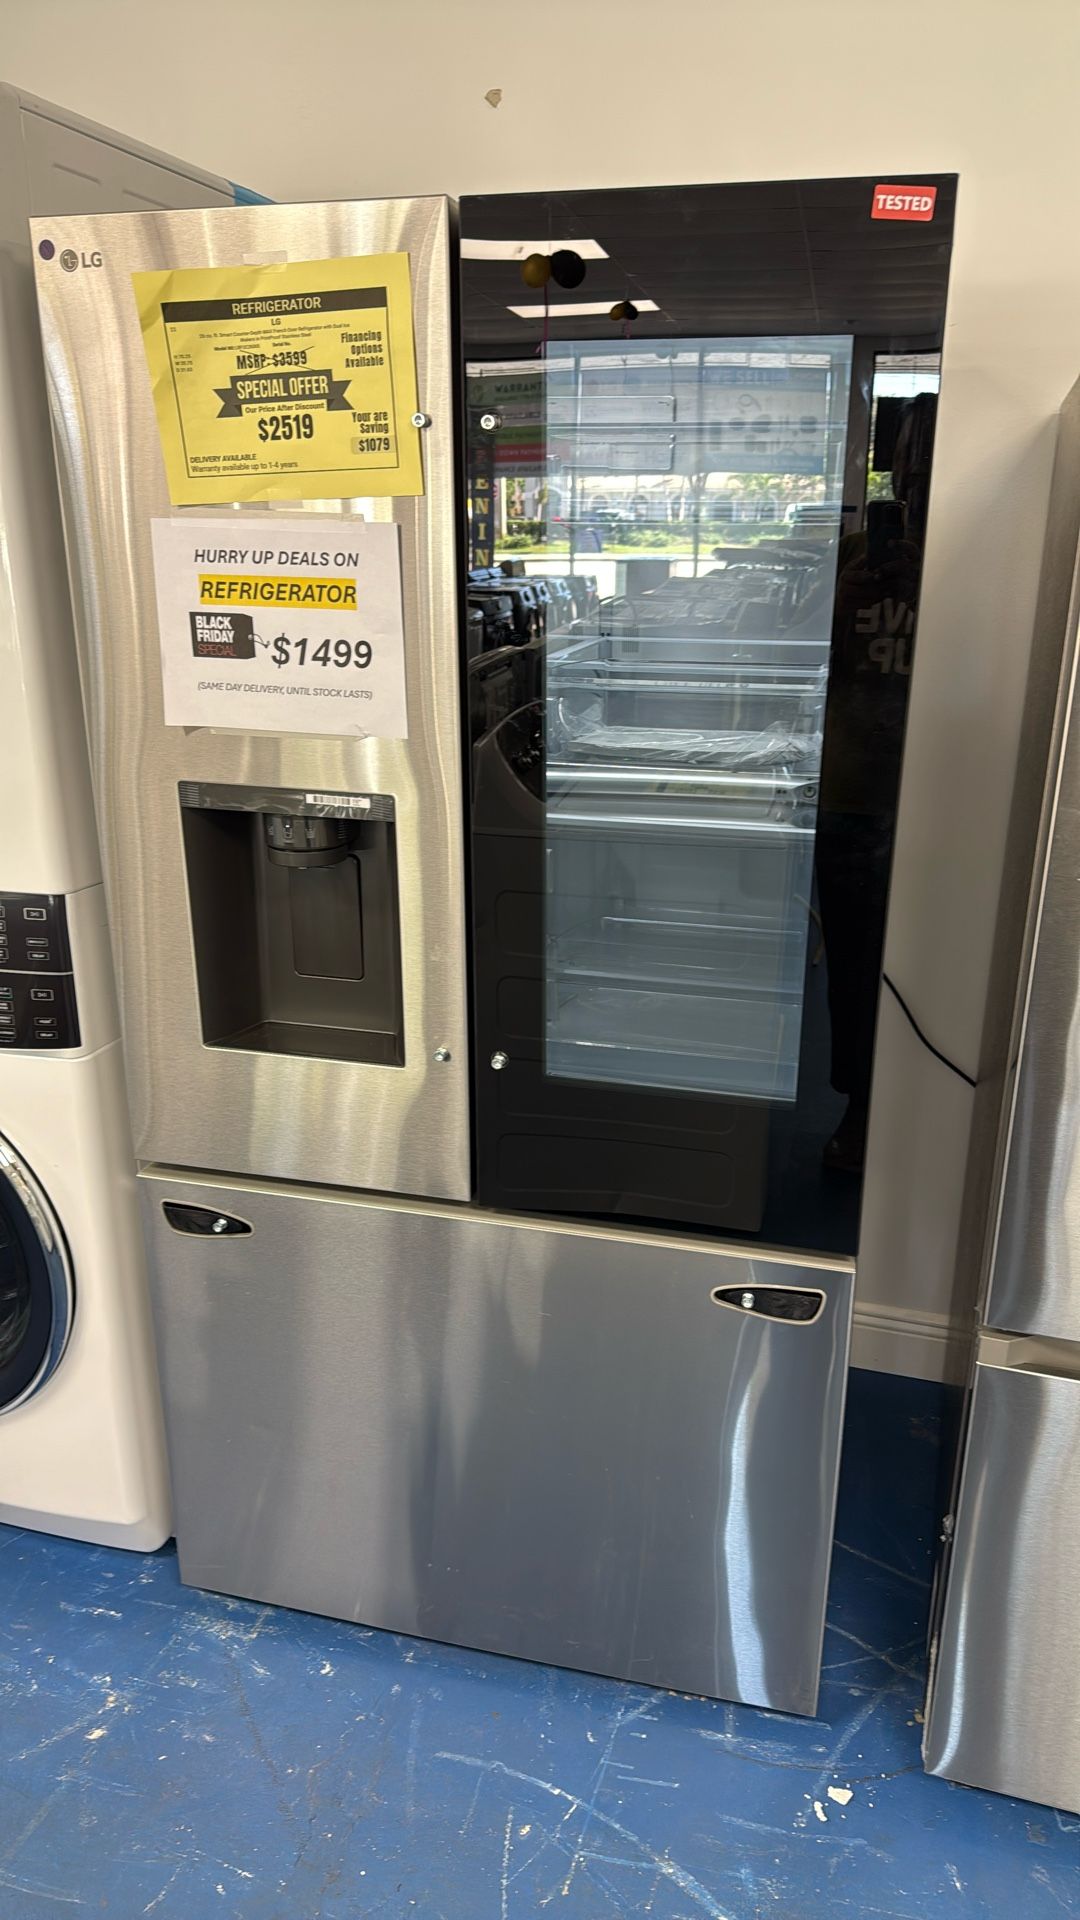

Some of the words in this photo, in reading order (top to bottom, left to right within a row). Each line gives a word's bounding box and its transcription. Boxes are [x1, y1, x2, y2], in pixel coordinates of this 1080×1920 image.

[876, 194, 932, 211] TESTED
[81, 251, 103, 268] LG
[232, 297, 322, 315] REFRIGERATOR
[271, 318, 281, 326] LG
[341, 331, 382, 343] Financing
[351, 343, 383, 356] Options
[272, 351, 307, 367] $3599
[345, 356, 384, 368] Available
[236, 378, 288, 400] SPECIAL
[288, 375, 329, 395] OFFER
[258, 405, 276, 413] Price
[295, 402, 325, 410] Discount
[352, 412, 371, 423] Your
[373, 411, 388, 421] are
[258, 414, 314, 442] $2519
[360, 422, 389, 434] Saving
[359, 437, 390, 452] $1079
[190, 455, 220, 463] DELIVERY
[222, 453, 257, 461] AVAILABLE
[191, 465, 221, 473] Warranty
[222, 463, 250, 471] available
[194, 549, 249, 564] HURRY
[251, 550, 274, 565] UP
[278, 551, 330, 566] DEALS
[333, 552, 359, 567] ON
[200, 581, 357, 603] REFRIGERATOR
[195, 615, 233, 630] BLACK
[197, 629, 235, 643] FRIDAY
[198, 644, 238, 657] SPECIAL
[271, 632, 373, 669] $1499
[198, 681, 225, 691] (SAME
[225, 682, 243, 692] DAY
[243, 683, 285, 695] DELIVERY,
[286, 686, 312, 696] UNTIL
[312, 687, 342, 698] STOCK
[343, 690, 373, 700] LASTS)
